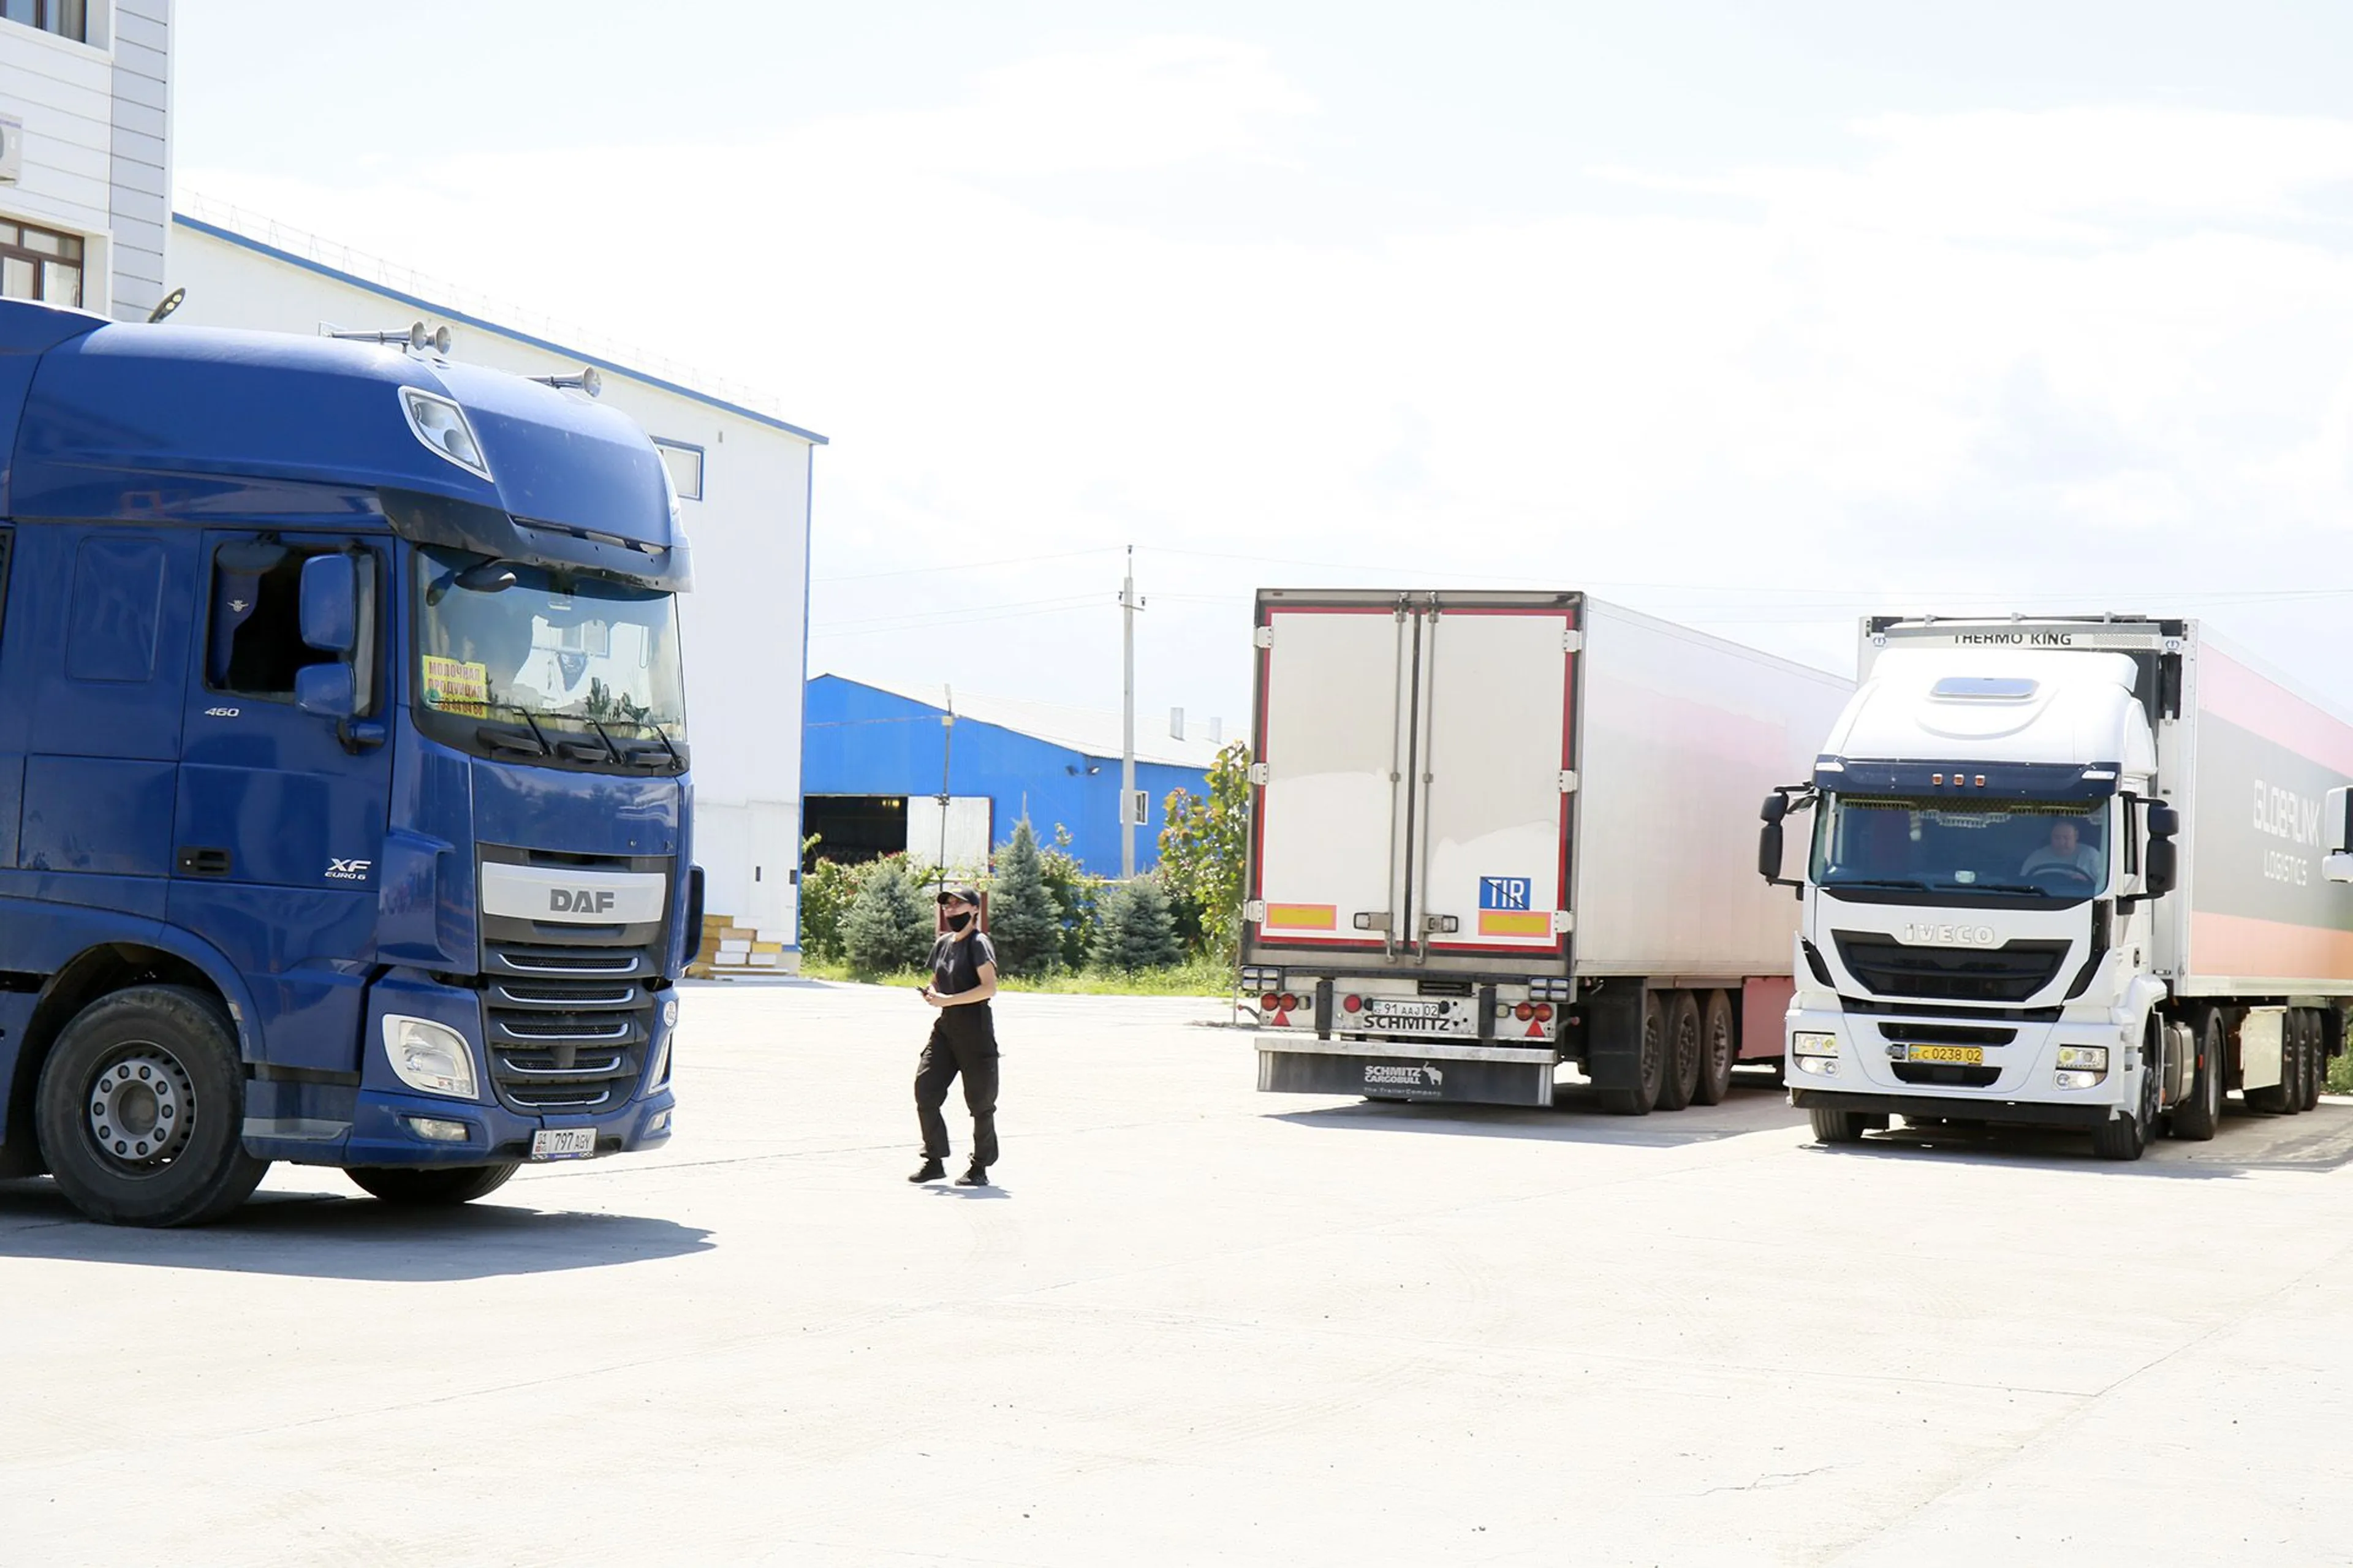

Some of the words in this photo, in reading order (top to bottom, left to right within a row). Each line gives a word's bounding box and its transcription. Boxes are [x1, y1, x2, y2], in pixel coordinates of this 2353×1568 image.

[2031, 633, 2072, 646] KING
[205, 707, 240, 717] 460
[328, 858, 372, 873] XF
[2264, 849, 2308, 886] LOGISTICS
[1487, 878, 1525, 908] TIR
[550, 888, 615, 914] DAF
[1904, 923, 1995, 945] IVECO
[1384, 1003, 1398, 1015] 91
[1423, 1005, 1438, 1017] 02
[1364, 1015, 1450, 1031] SCHMITZ
[1922, 1050, 1929, 1059] C
[1931, 1048, 1962, 1061] 0238
[1966, 1050, 1982, 1061] 02
[1365, 1066, 1422, 1077] SCHMITZ
[1365, 1075, 1421, 1085] CARGOBULL
[554, 1132, 574, 1151] 797
